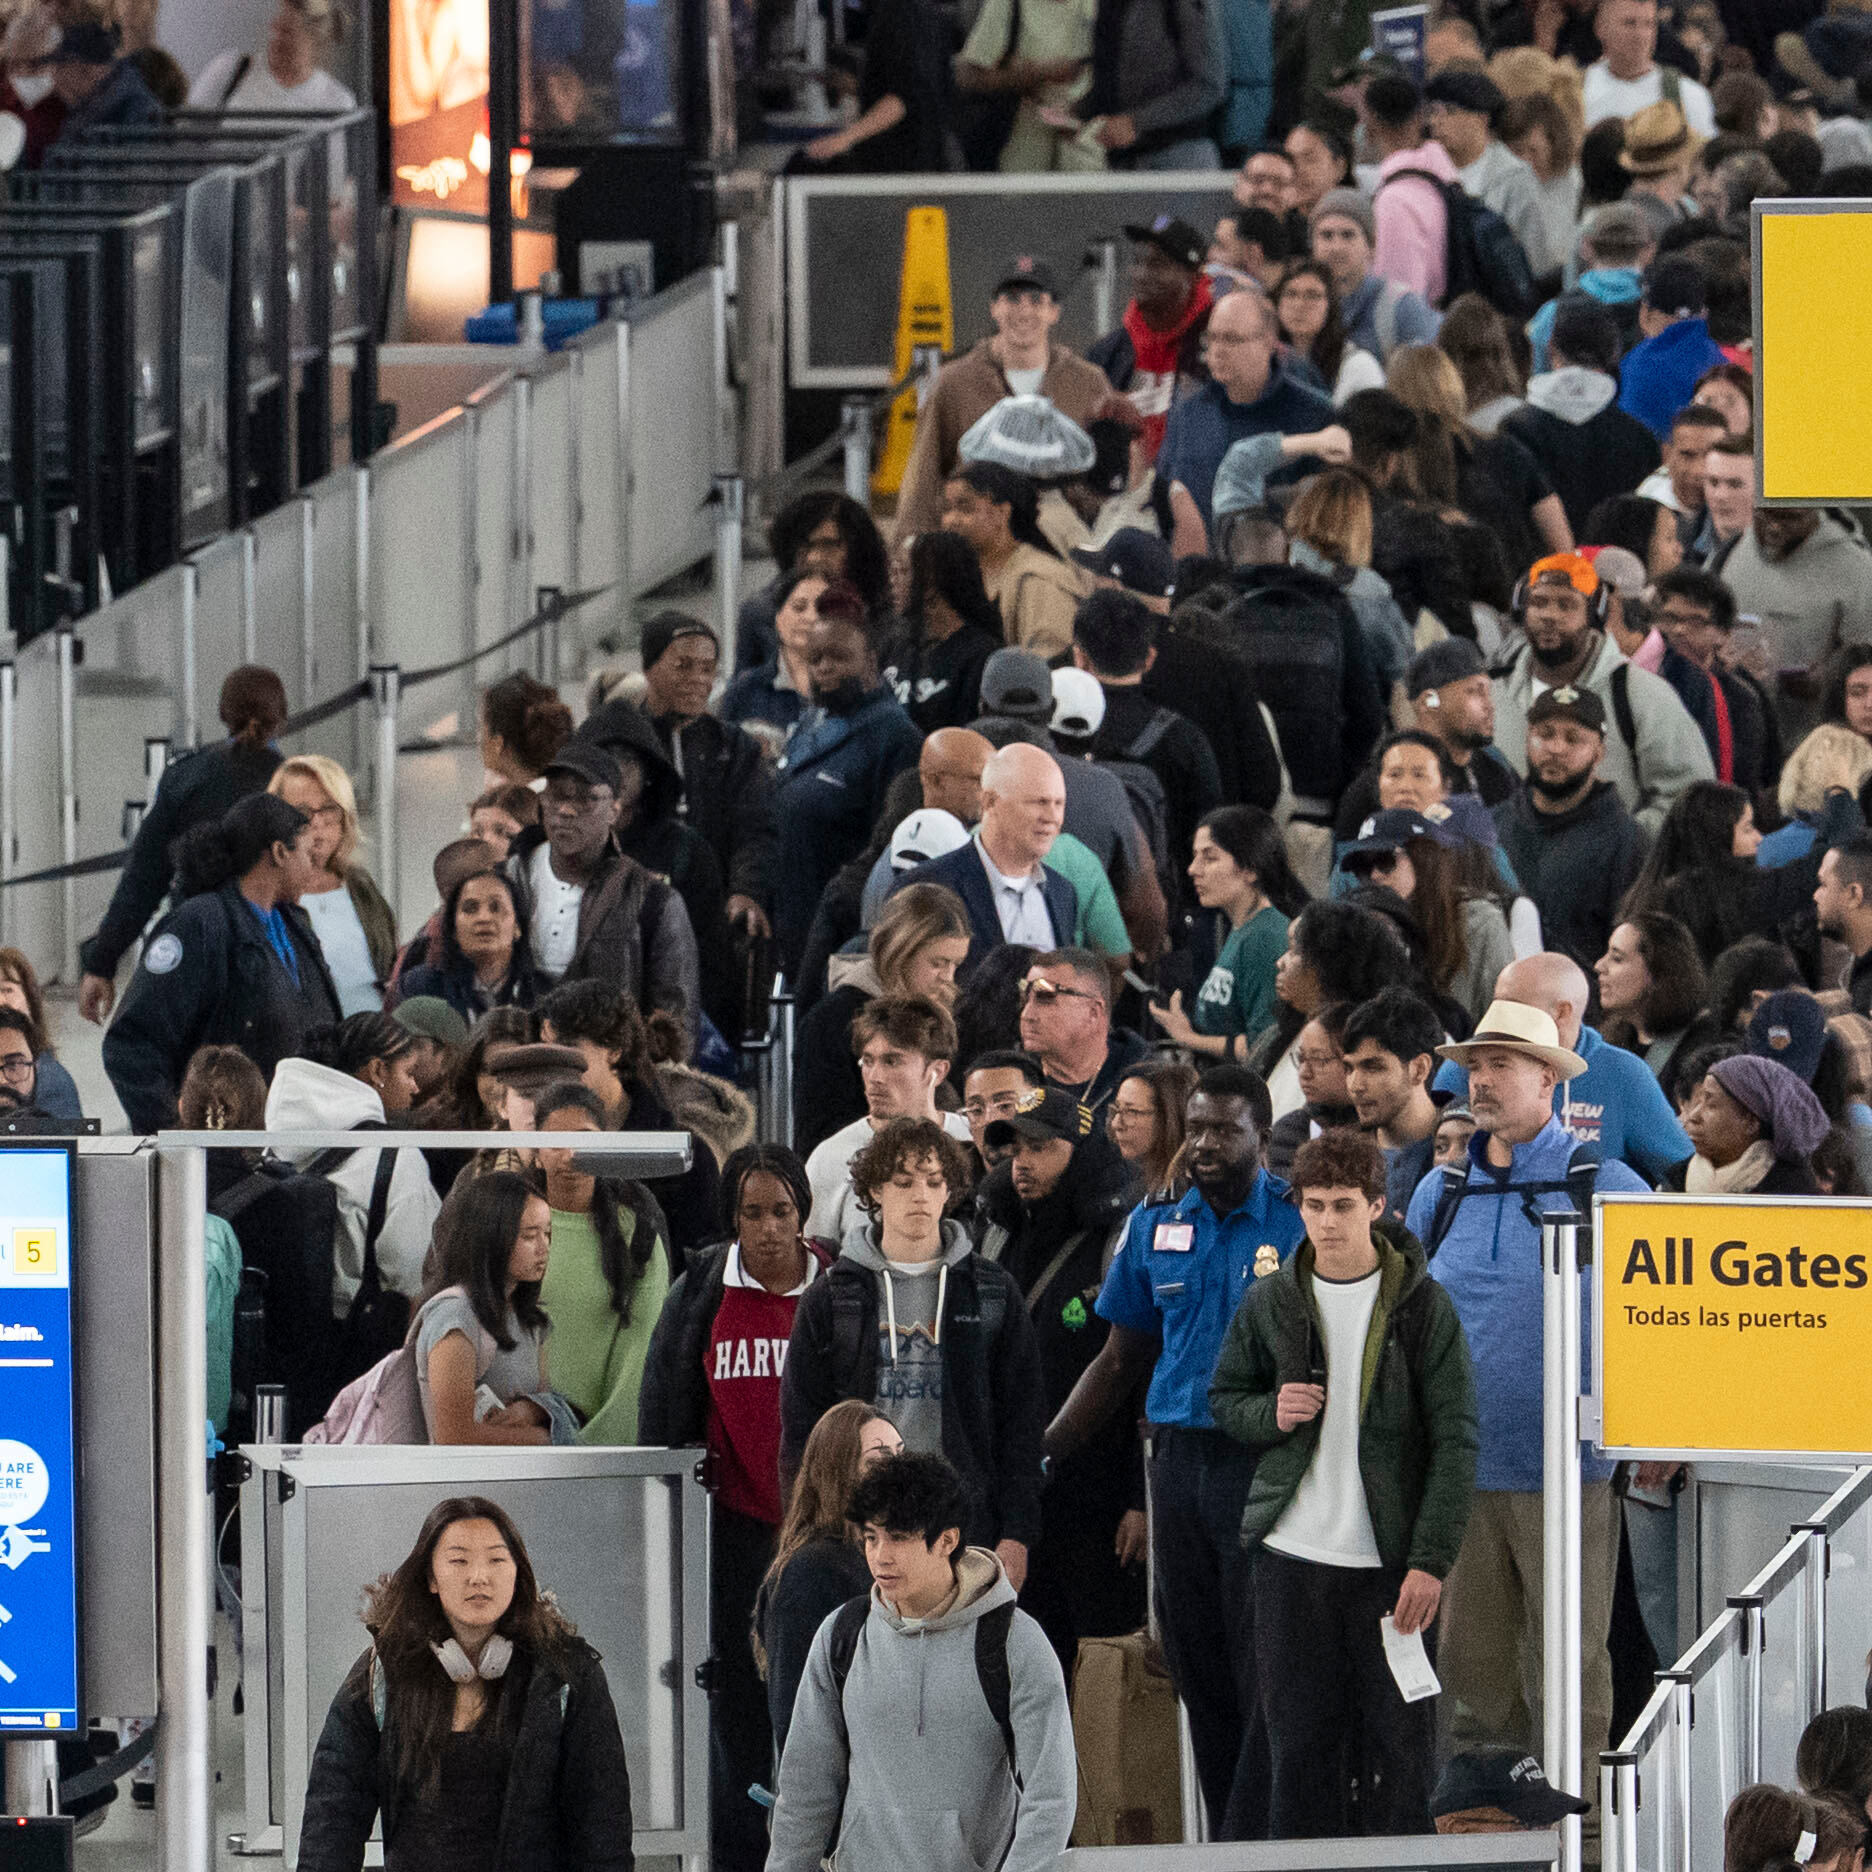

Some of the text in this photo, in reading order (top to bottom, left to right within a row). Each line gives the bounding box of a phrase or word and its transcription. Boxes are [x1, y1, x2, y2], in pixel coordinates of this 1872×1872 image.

[29, 1242, 39, 1262] 5
[1622, 1238, 1867, 1288] All Gates
[1624, 1306, 1827, 1332] Todas las puertas
[714, 1338, 789, 1380] HARV
[7, 1463, 33, 1473] ARE
